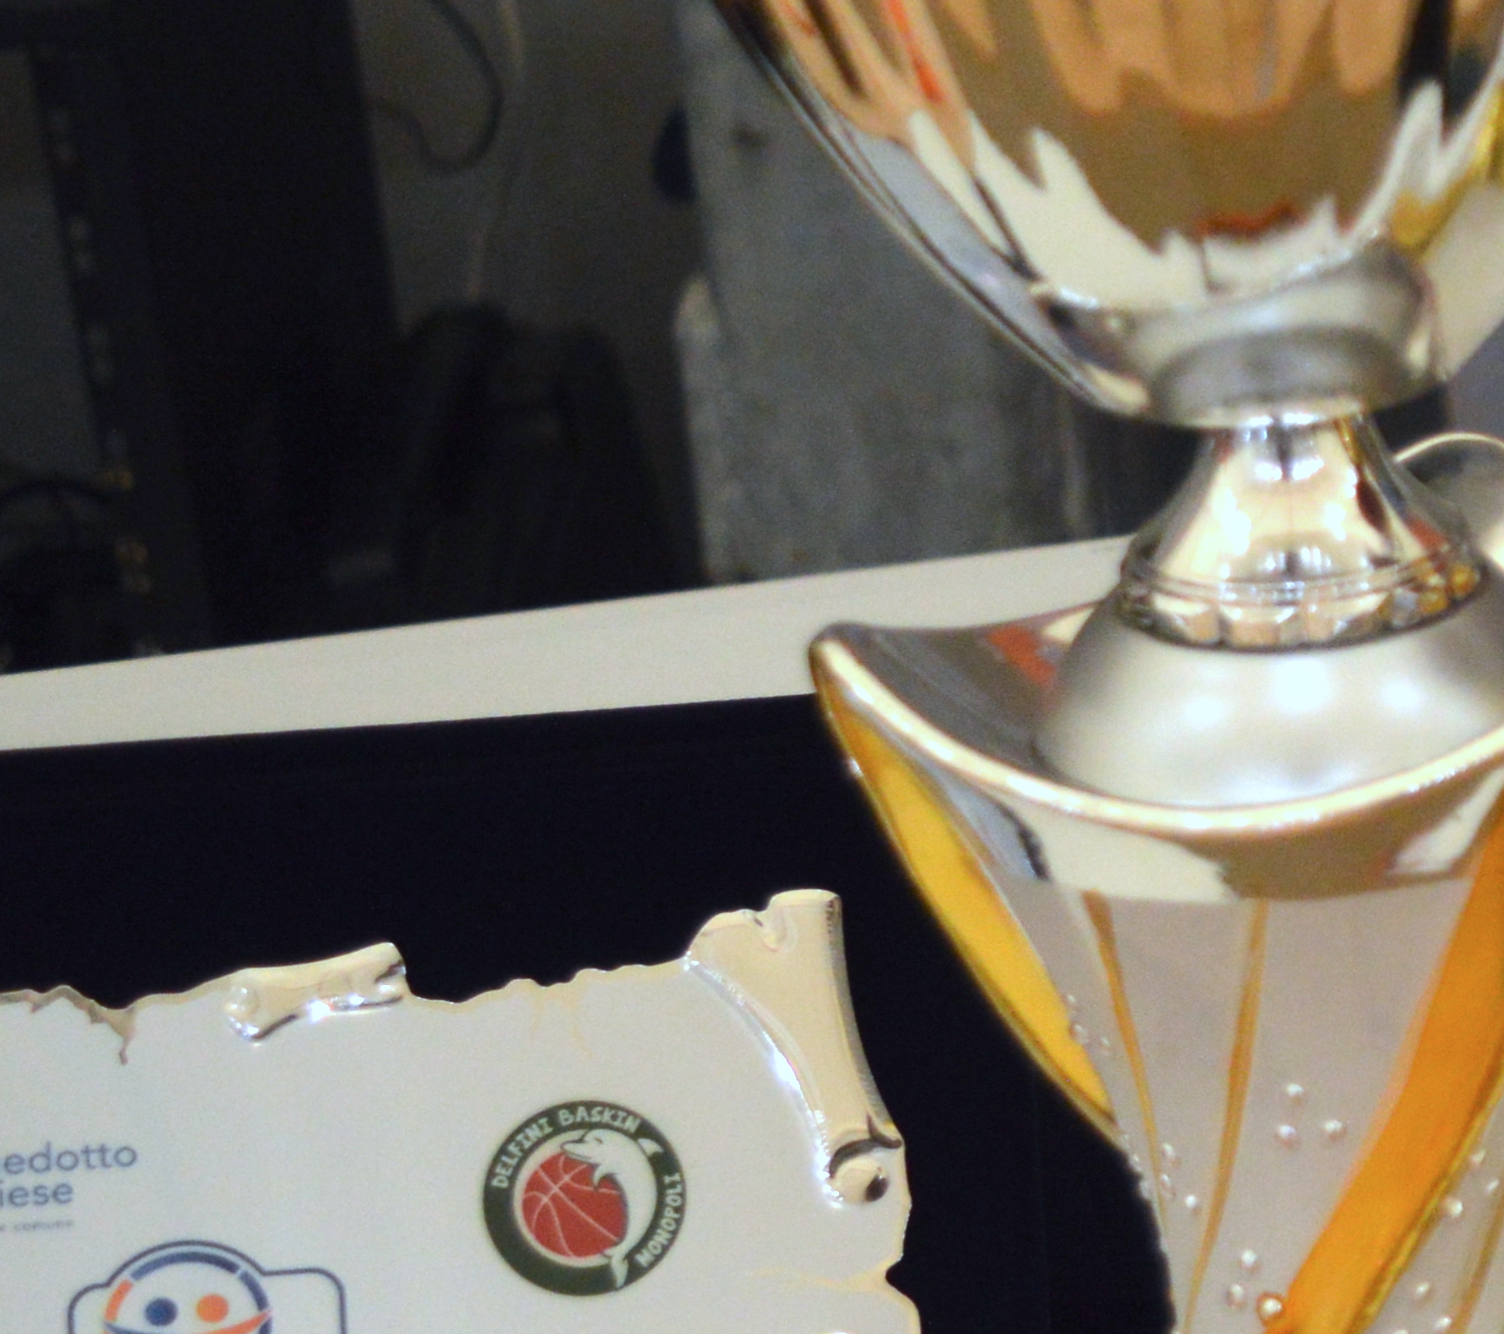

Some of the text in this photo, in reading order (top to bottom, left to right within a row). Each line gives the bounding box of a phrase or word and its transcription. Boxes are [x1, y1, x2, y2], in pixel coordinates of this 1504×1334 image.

[490, 1116, 556, 1190] DELFINI
[557, 1105, 642, 1134] BASKIN
[634, 1171, 684, 1268] MONOPOLI
